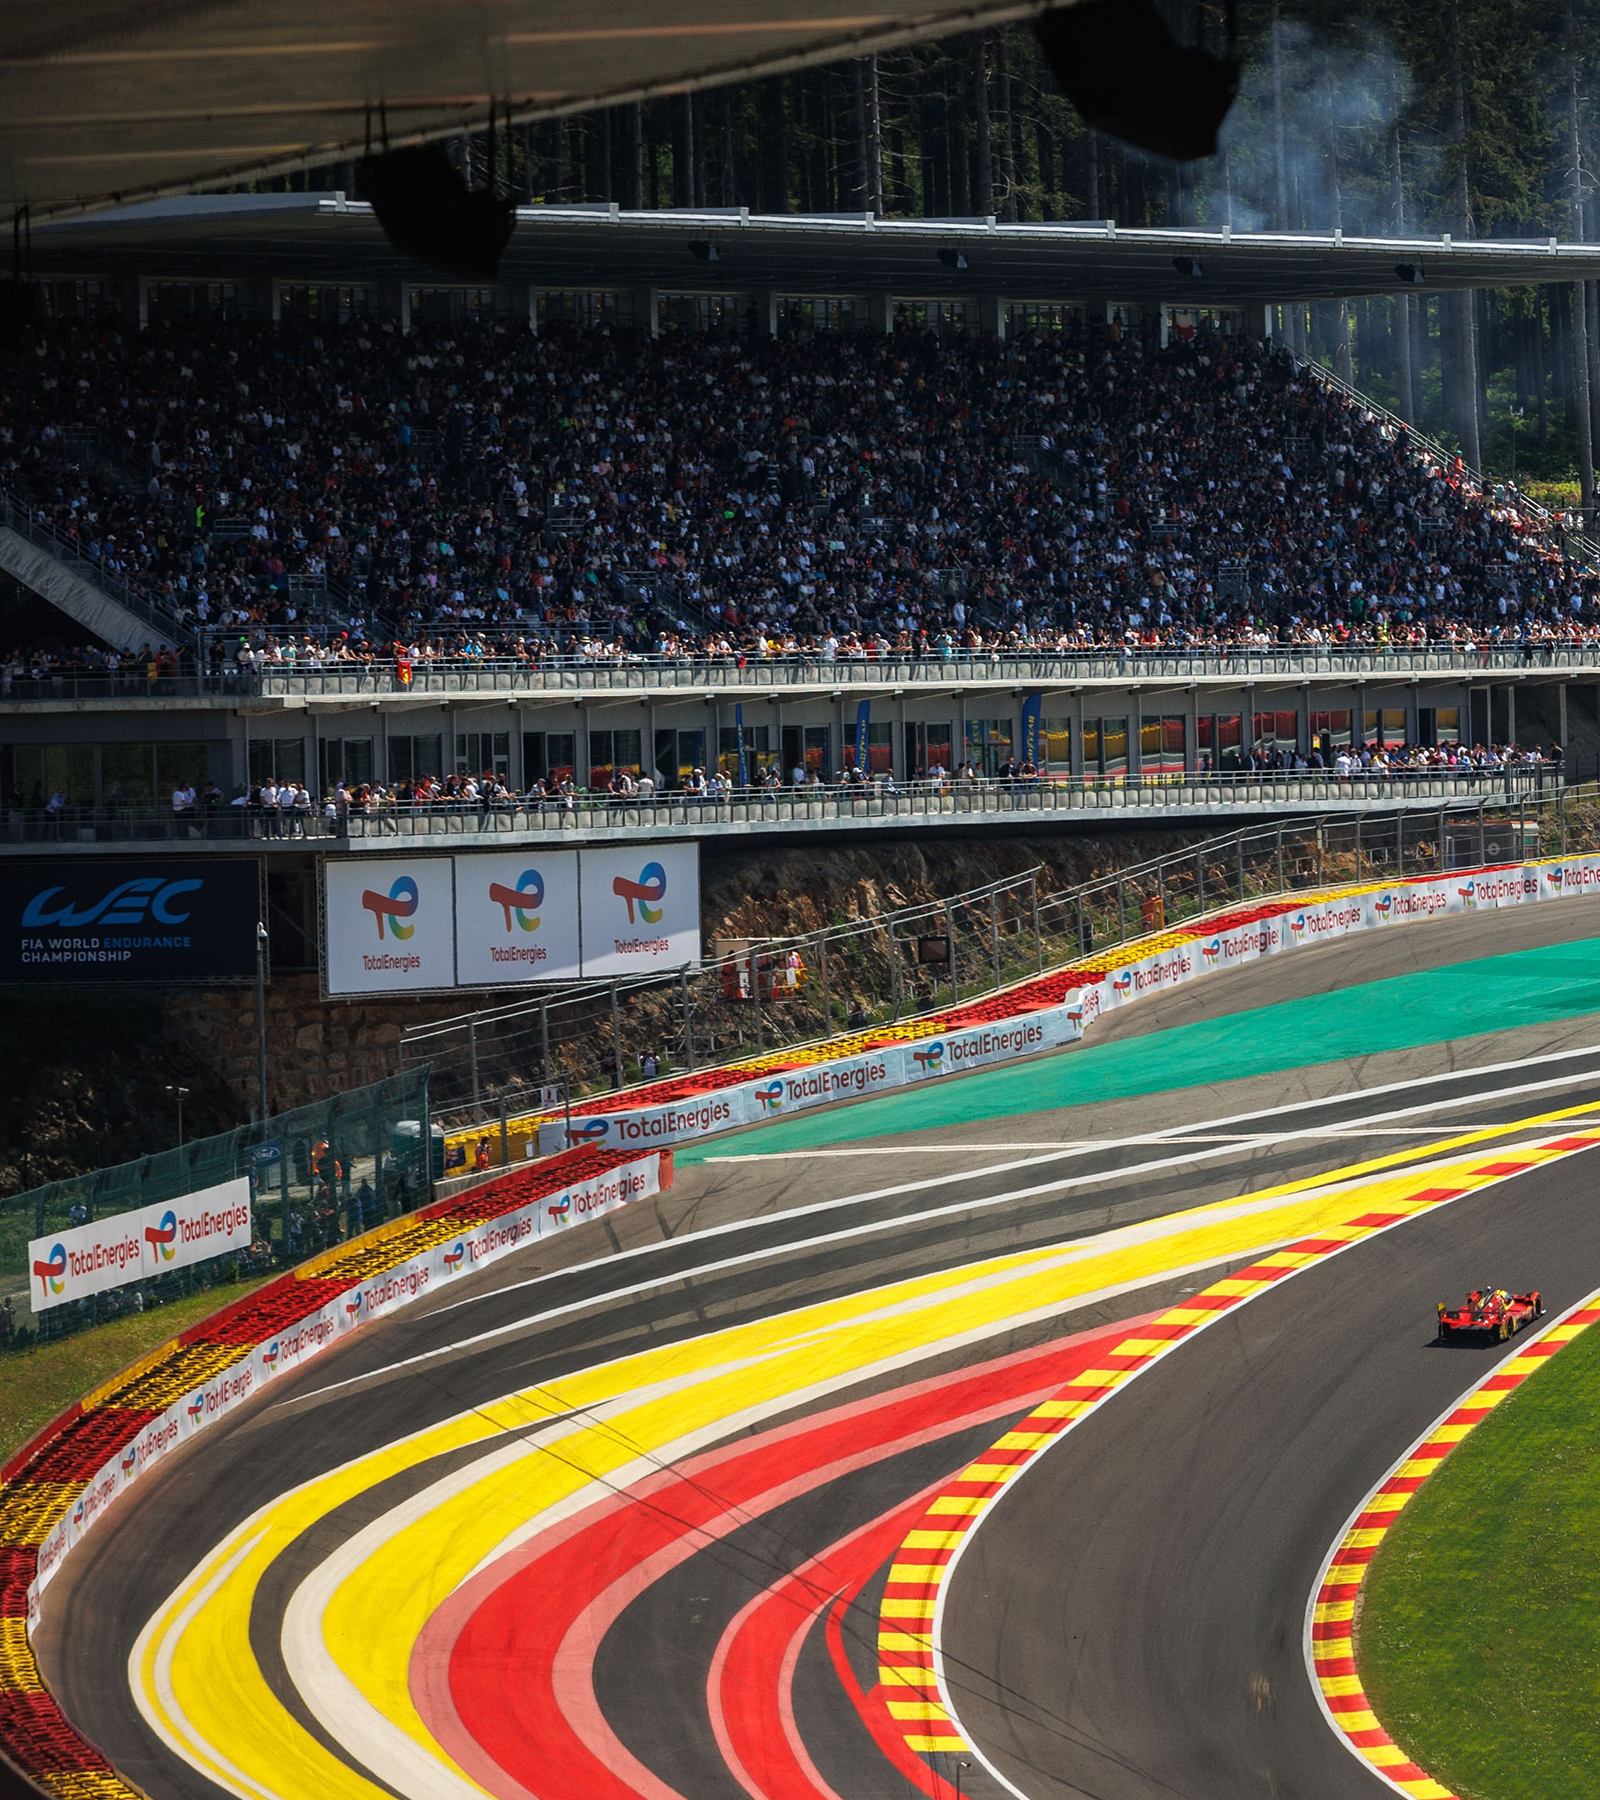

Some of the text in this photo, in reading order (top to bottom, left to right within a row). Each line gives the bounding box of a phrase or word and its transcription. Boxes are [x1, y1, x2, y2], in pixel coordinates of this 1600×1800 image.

[22, 878, 203, 927] WEC
[1393, 889, 1446, 914] TotalEnergies
[22, 937, 191, 949] FIA WORLD ENDURANCE
[22, 951, 131, 963] CHAMPIONSHIP
[362, 952, 421, 972] TotalEnergies
[490, 944, 547, 964] TotalEnergies
[614, 936, 669, 955] TotalEnergies
[1133, 954, 1191, 991] TotalEnergies
[947, 1024, 1043, 1062] TotalEnergies
[786, 1062, 886, 1100] TotalEnergies
[614, 1100, 730, 1140] TotalEnergies
[572, 1173, 645, 1214] TotalEnergies
[178, 1202, 247, 1243] TotalEnergies
[466, 1218, 531, 1262] TotalEnergies
[69, 1234, 139, 1277] TotalEnergies
[364, 1266, 428, 1311] TotalEnergies
